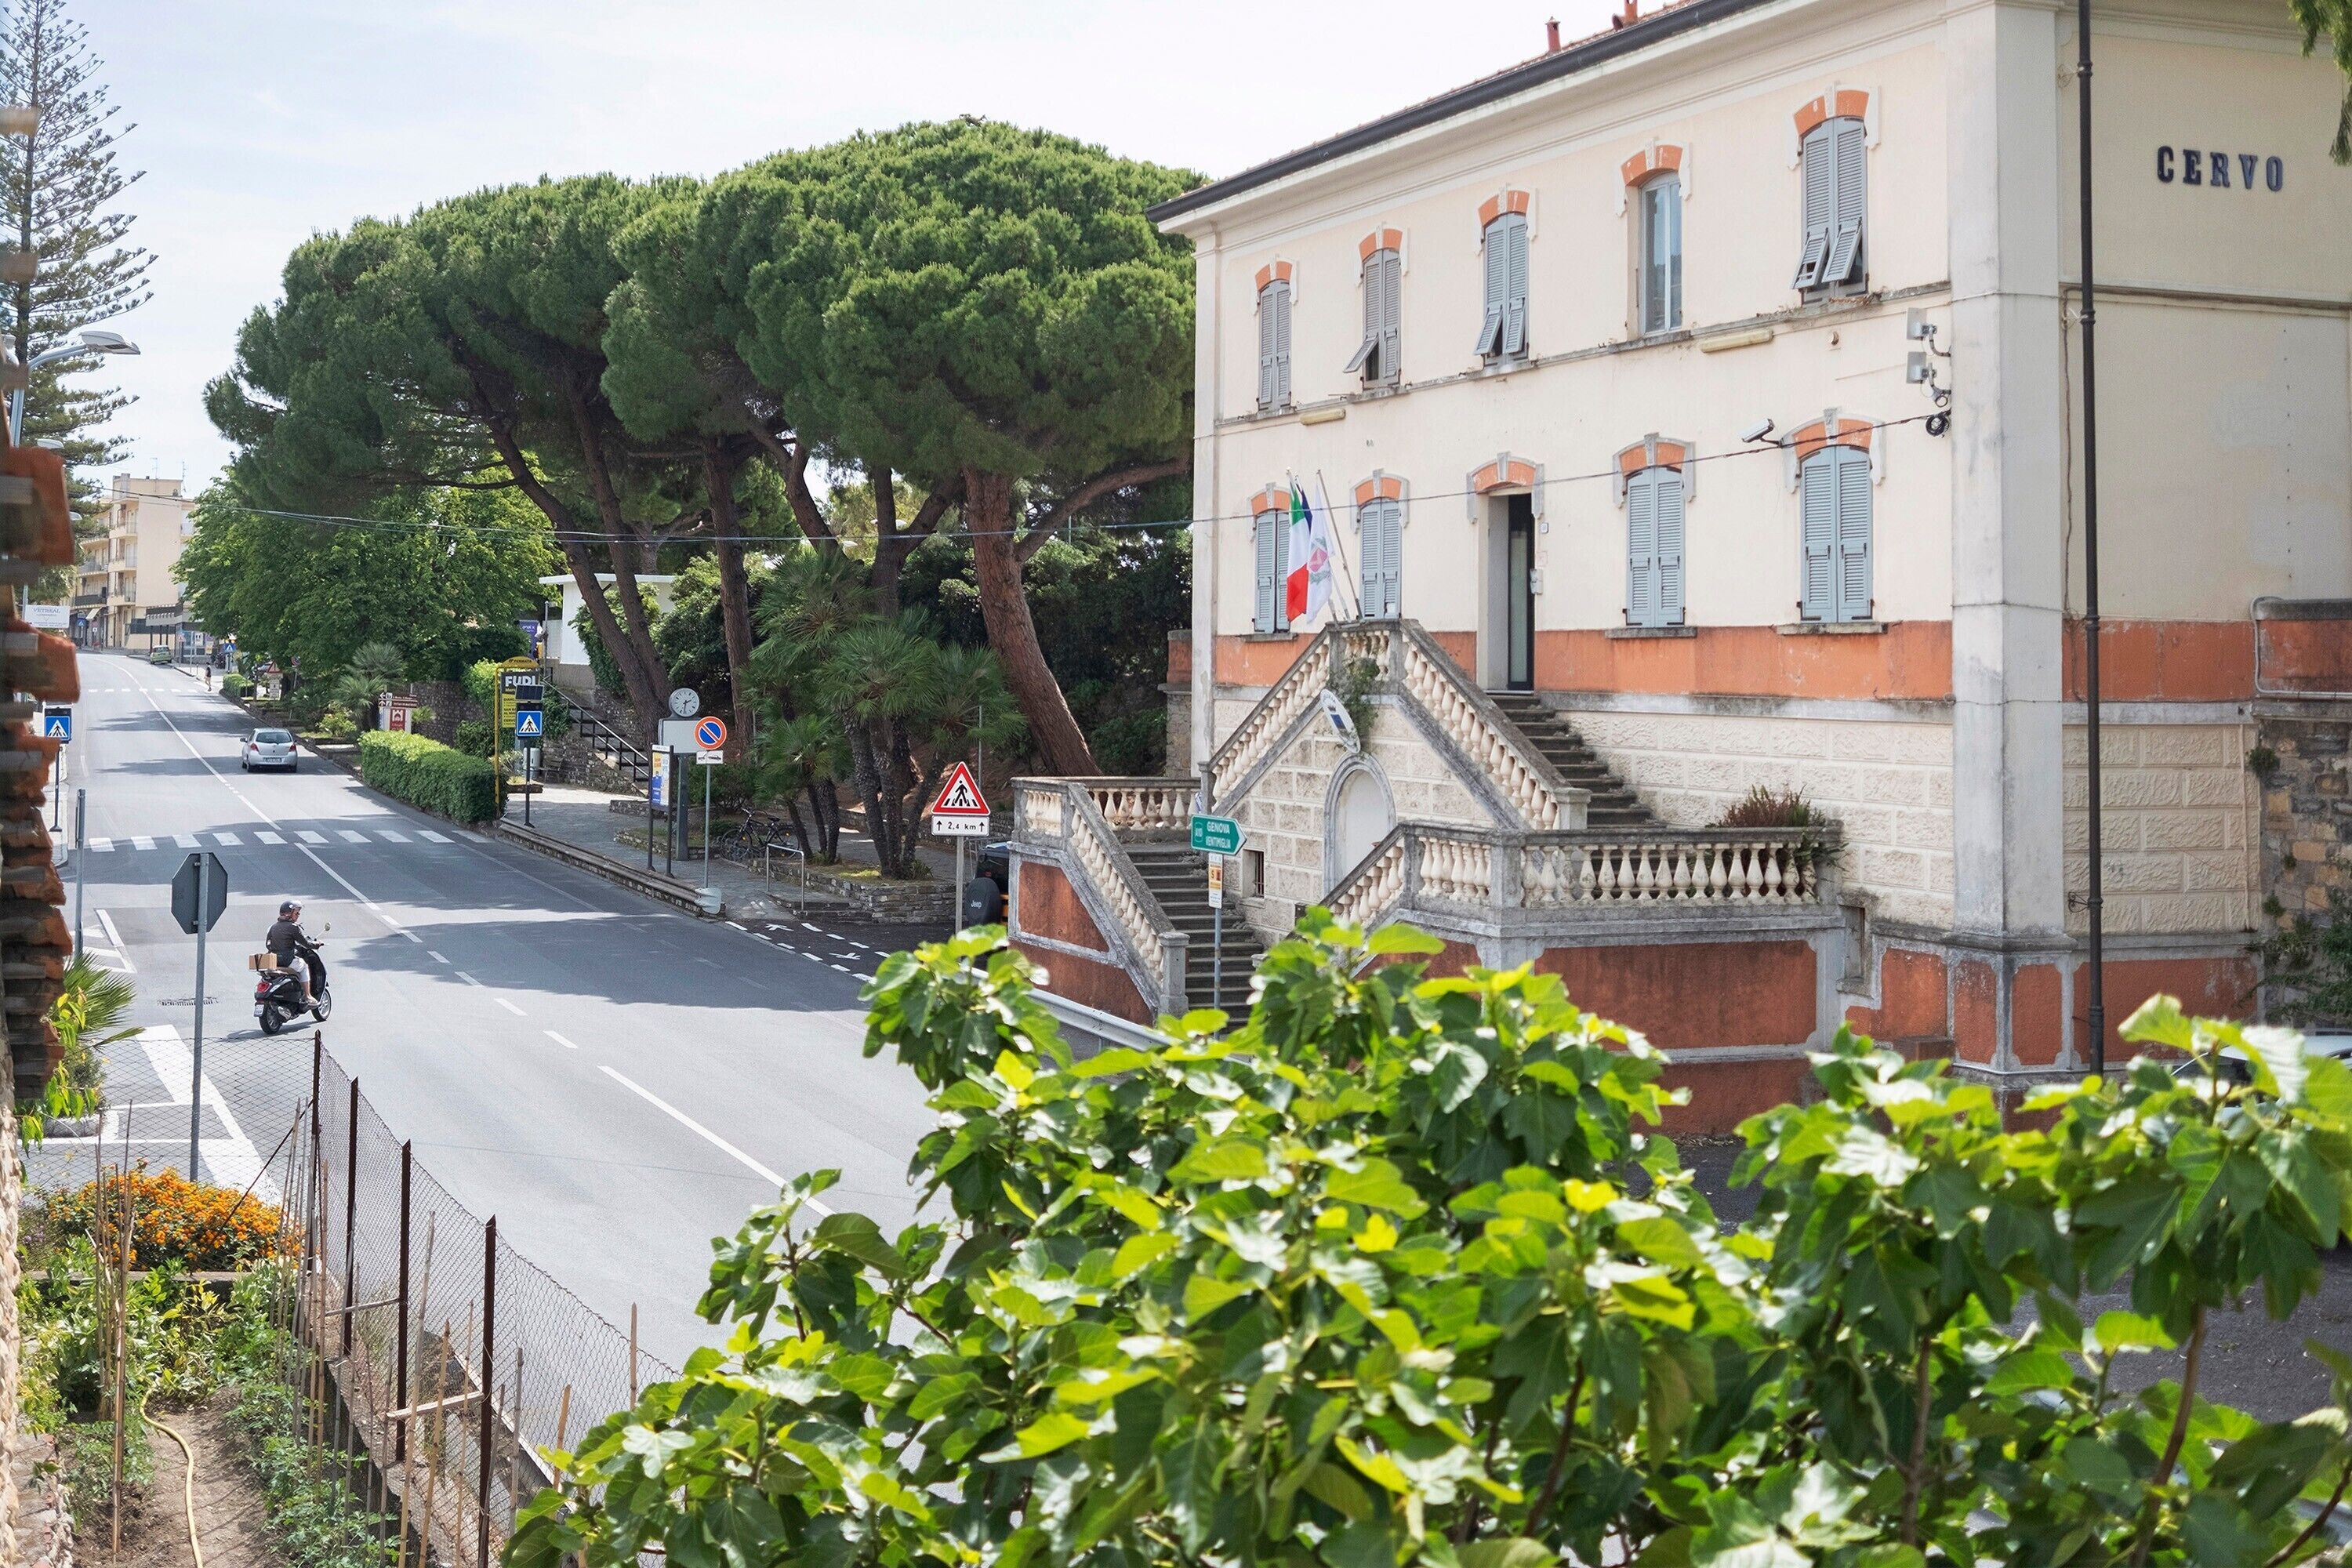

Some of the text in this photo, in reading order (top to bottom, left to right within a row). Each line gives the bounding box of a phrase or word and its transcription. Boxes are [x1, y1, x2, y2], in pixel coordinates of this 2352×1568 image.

[2157, 146, 2284, 192] CERVO
[1207, 821, 1230, 834] GENOVA
[971, 900, 982, 909] Jeep
